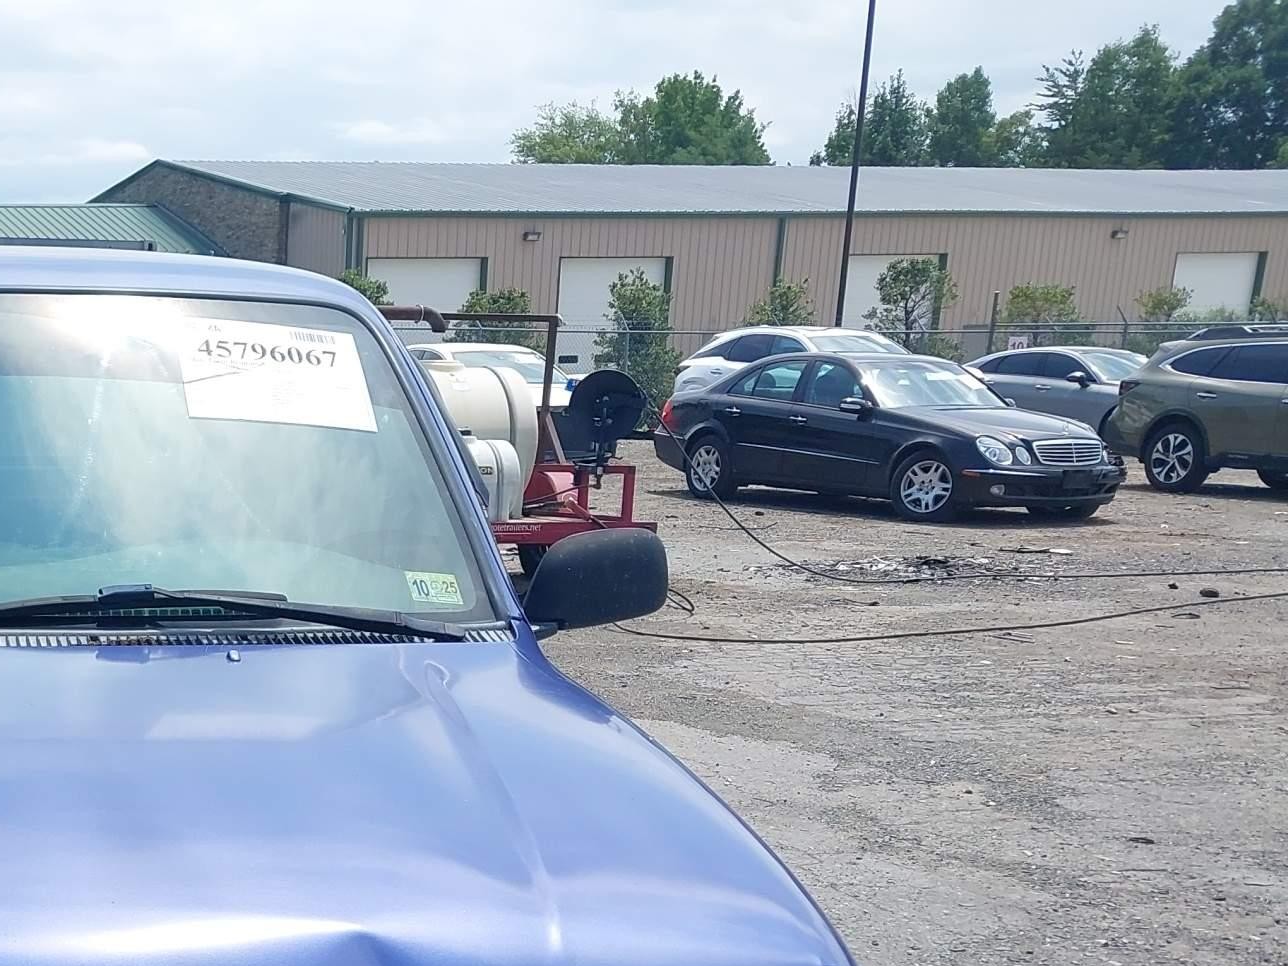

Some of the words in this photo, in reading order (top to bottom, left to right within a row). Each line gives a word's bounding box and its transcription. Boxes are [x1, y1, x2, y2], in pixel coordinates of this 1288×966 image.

[197, 339, 337, 367] 45796067
[412, 579, 430, 597] 10
[441, 581, 458, 594] 25
